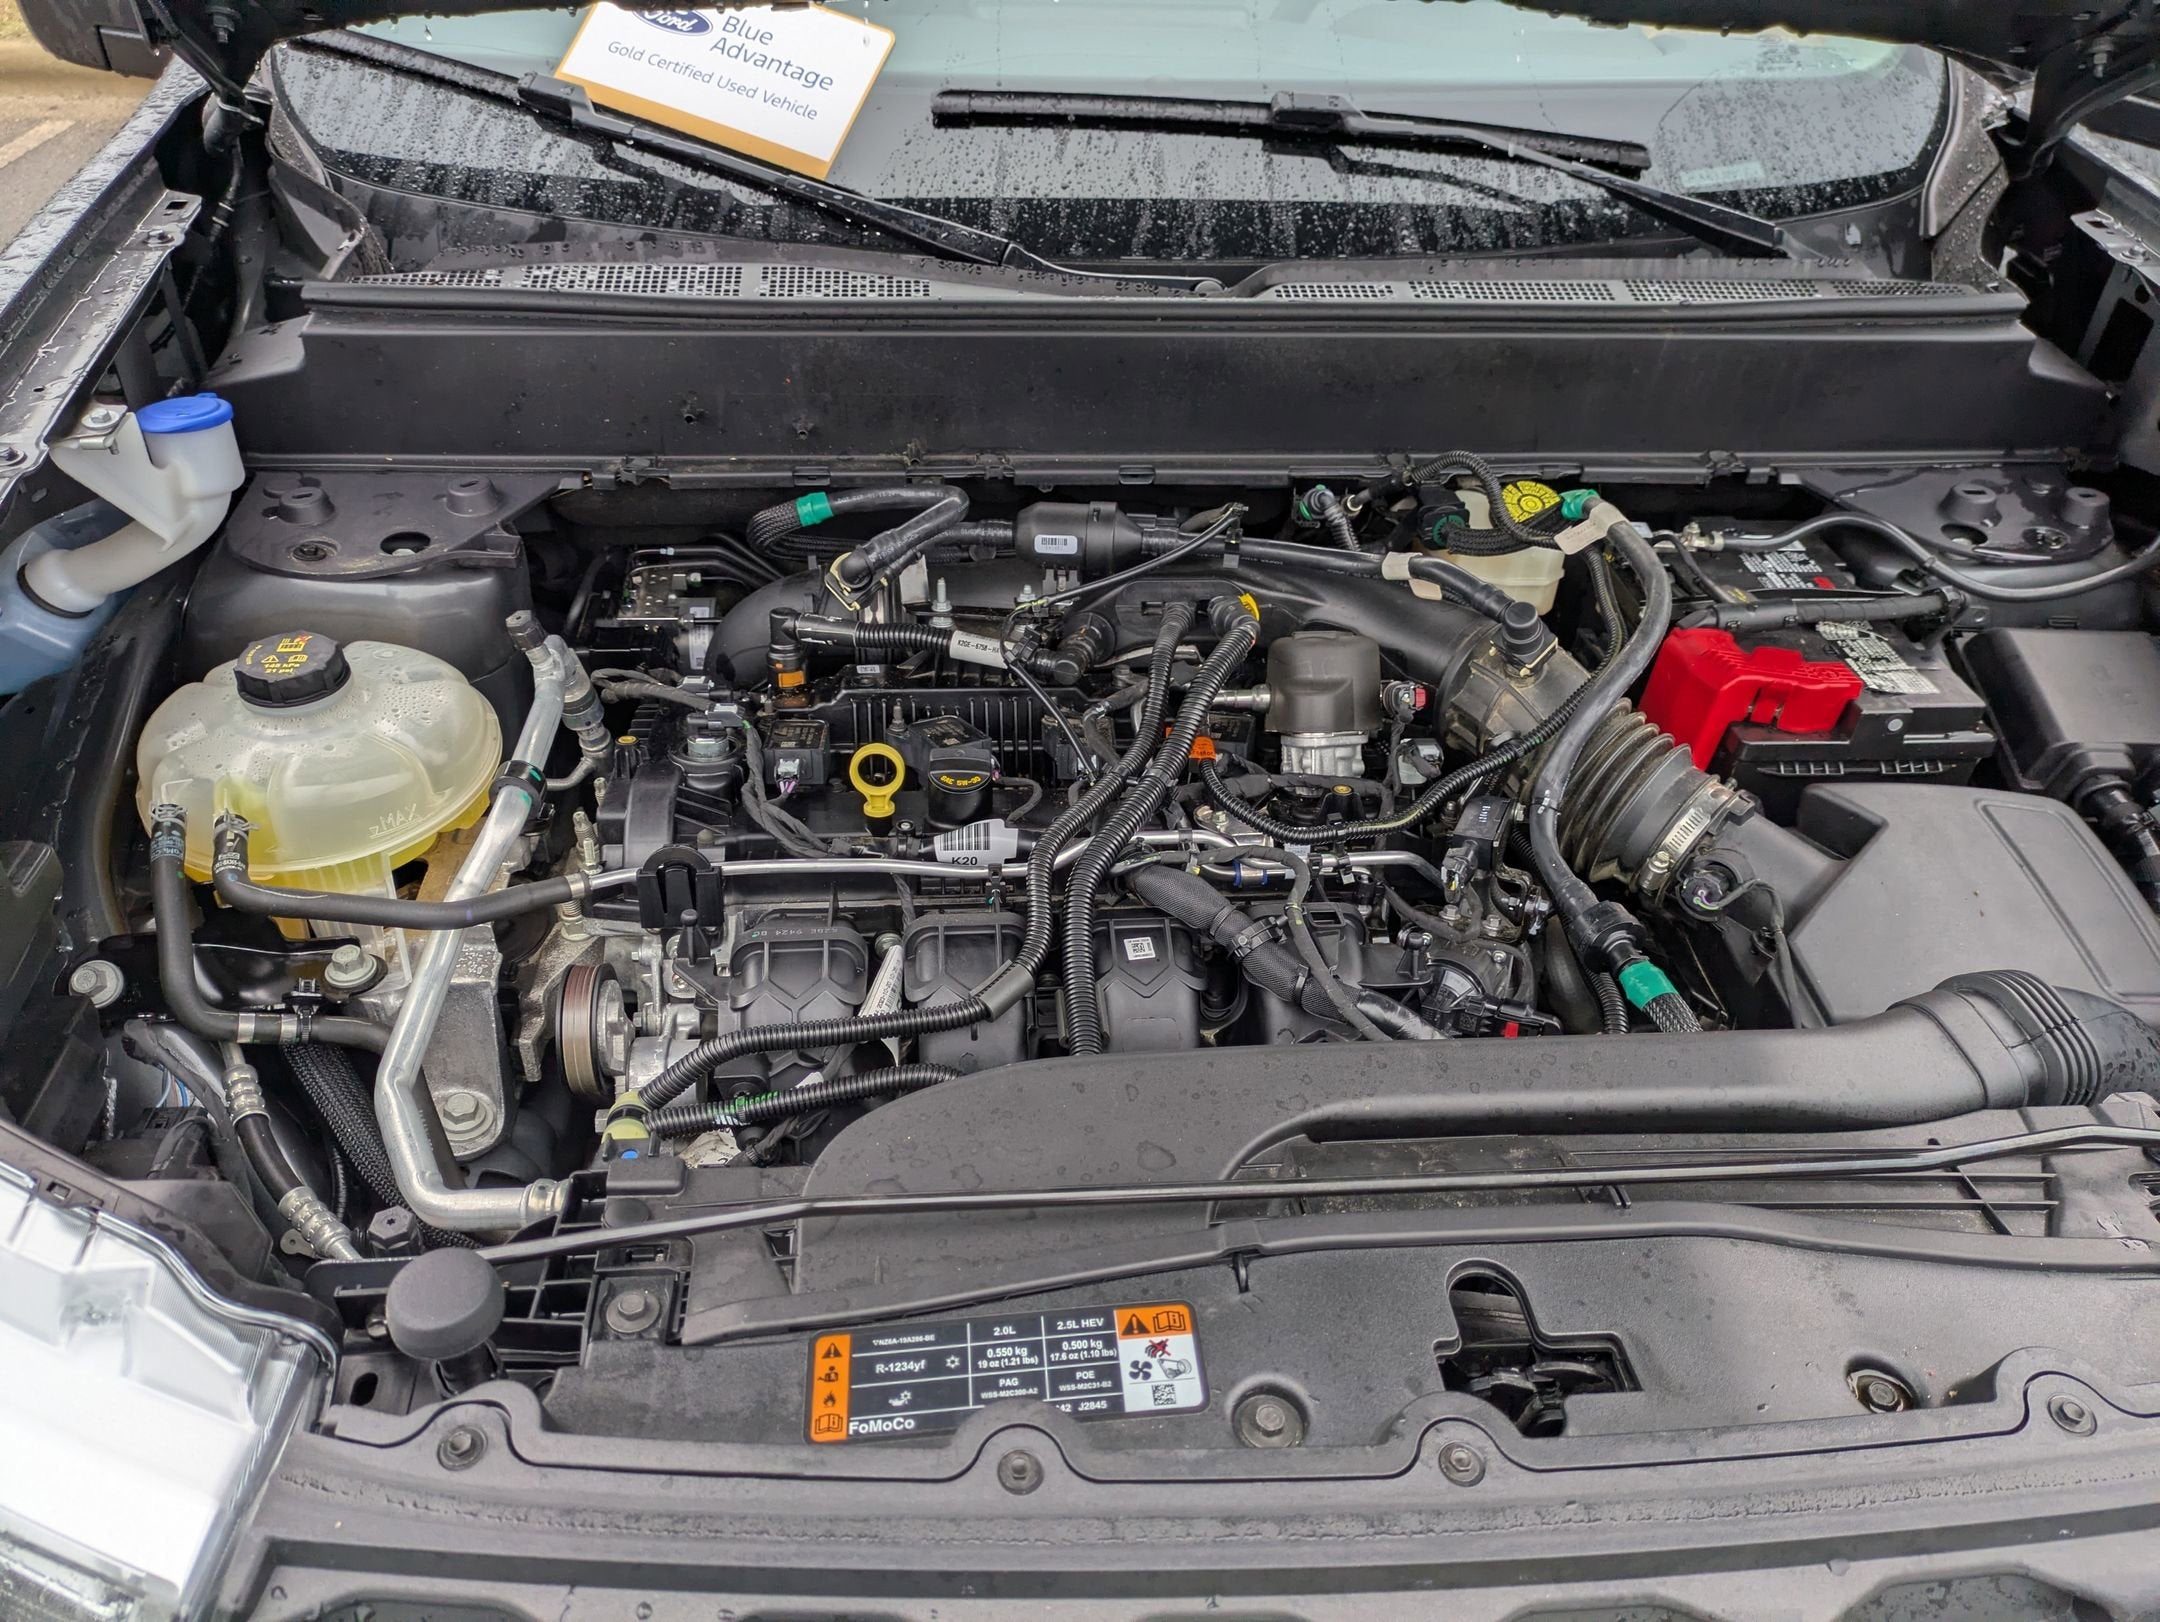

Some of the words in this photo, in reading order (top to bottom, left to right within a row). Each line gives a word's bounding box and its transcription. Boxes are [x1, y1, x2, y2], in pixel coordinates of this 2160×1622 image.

[721, 16, 774, 46] Blue
[709, 38, 834, 92] Advantage
[607, 41, 646, 61] Gold
[647, 53, 714, 84] Certified
[716, 76, 759, 99] Used
[762, 89, 818, 120] Vehicle
[380, 803, 421, 831] MAX
[951, 856, 978, 865] K20
[1056, 1320, 1079, 1330] 2.5L
[1081, 1318, 1104, 1328] HEV
[993, 1325, 1016, 1336] 2.0L
[1062, 1340, 1088, 1351] 0.500
[1090, 1339, 1103, 1349] kg
[986, 1348, 1013, 1358] 0.550
[1015, 1346, 1028, 1357] kg
[1050, 1353, 1067, 1361] 17.6
[1080, 1350, 1100, 1360] (1.10
[1101, 1349, 1117, 1358] lbs)
[875, 1359, 927, 1374] R-1234yf
[977, 1360, 988, 1368] 19
[1001, 1357, 1020, 1367] (1.21
[1022, 1356, 1039, 1366] lbs)
[1076, 1371, 1095, 1380] POE
[999, 1378, 1019, 1387] PAG
[1056, 1403, 1072, 1412] 42
[1078, 1400, 1108, 1411] J2845
[848, 1417, 915, 1435] FoMoCo
